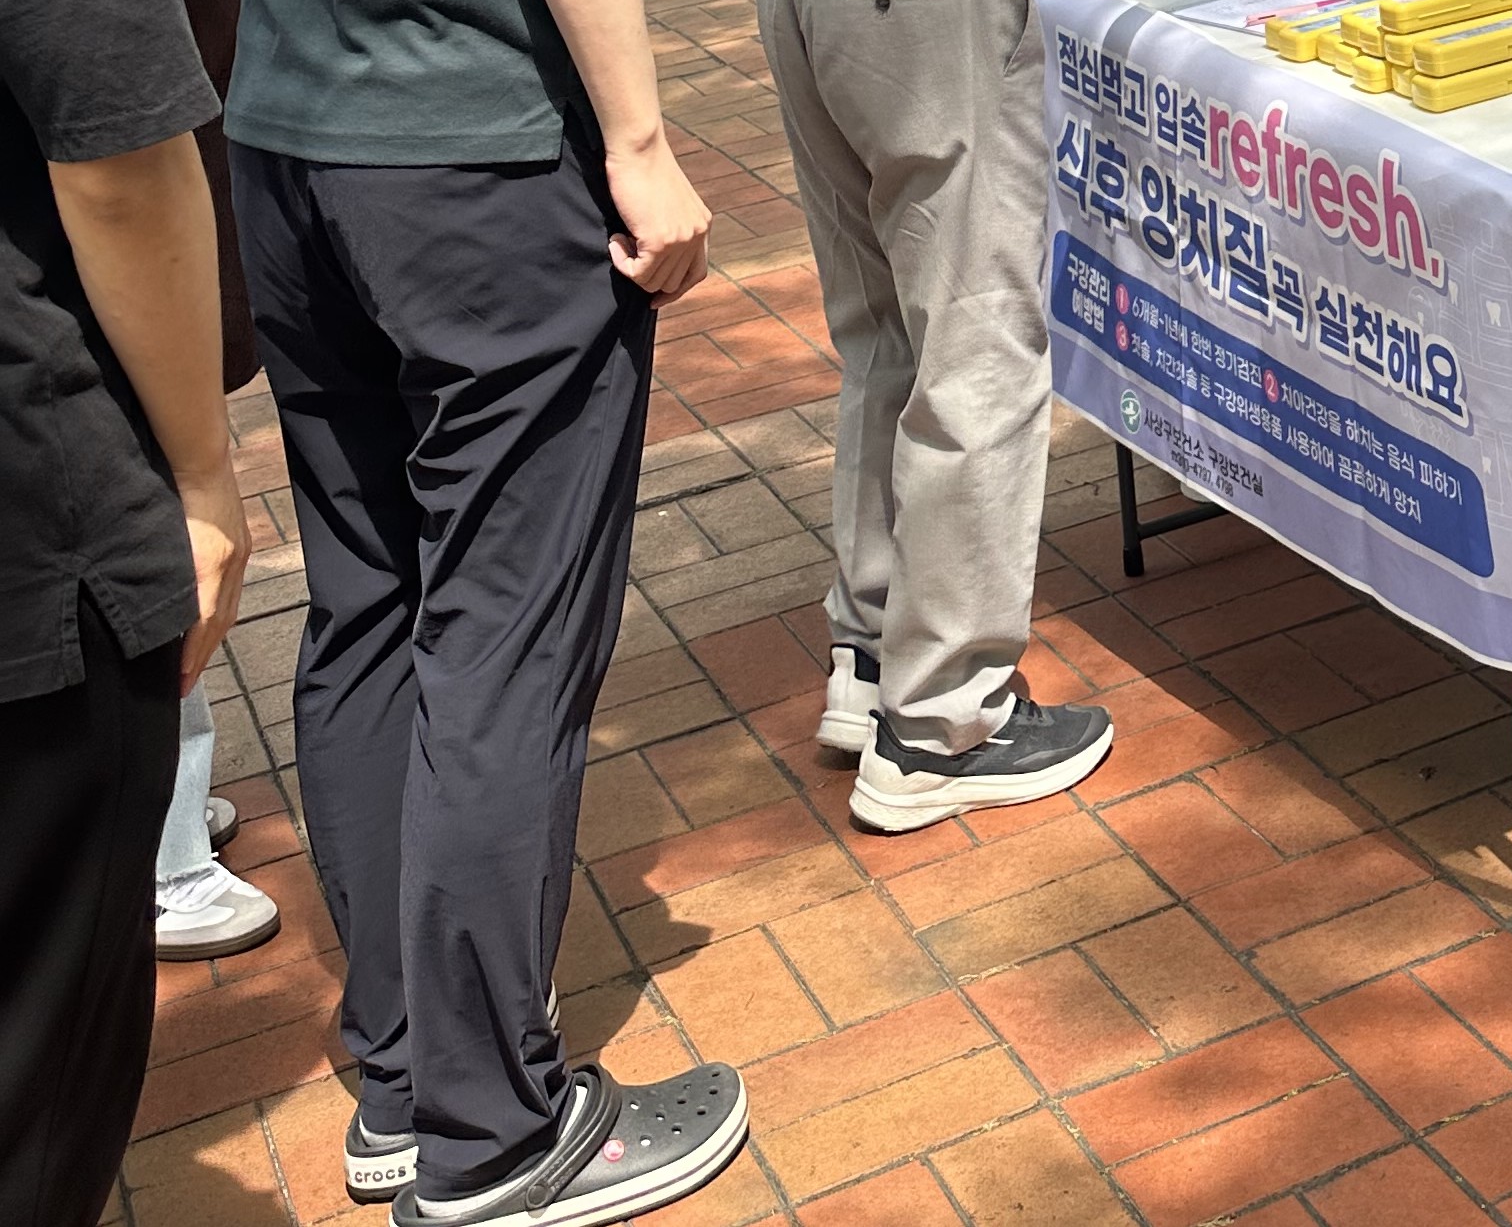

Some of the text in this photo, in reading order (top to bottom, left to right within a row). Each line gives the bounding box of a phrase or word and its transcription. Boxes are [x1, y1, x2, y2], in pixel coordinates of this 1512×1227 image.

[1058, 31, 1147, 128] 점심먹고
[1155, 82, 1206, 162] 입속
[1057, 119, 1128, 230] 식후
[1141, 164, 1270, 320] 양치질
[1315, 284, 1465, 417] 실천해요
[1067, 252, 1111, 307] 구강관리
[1071, 287, 1105, 334] 예방법
[1143, 407, 1264, 497] 사상구보건소 구강보건실
[1155, 347, 1198, 391] 치간칫솔
[1214, 381, 1283, 441] 구강위생용품
[1286, 424, 1335, 473] 사용하여
[1338, 452, 1391, 506] 꼼꼼하게
[1392, 487, 1422, 524] 양치
[1214, 343, 1263, 389] 정기검진
[1281, 381, 1342, 437] 치아건강을
[1344, 416, 1385, 461] 해치는
[1386, 442, 1416, 481] 음식
[1418, 459, 1463, 506] 피하기
[355, 1166, 406, 1184] crocs
